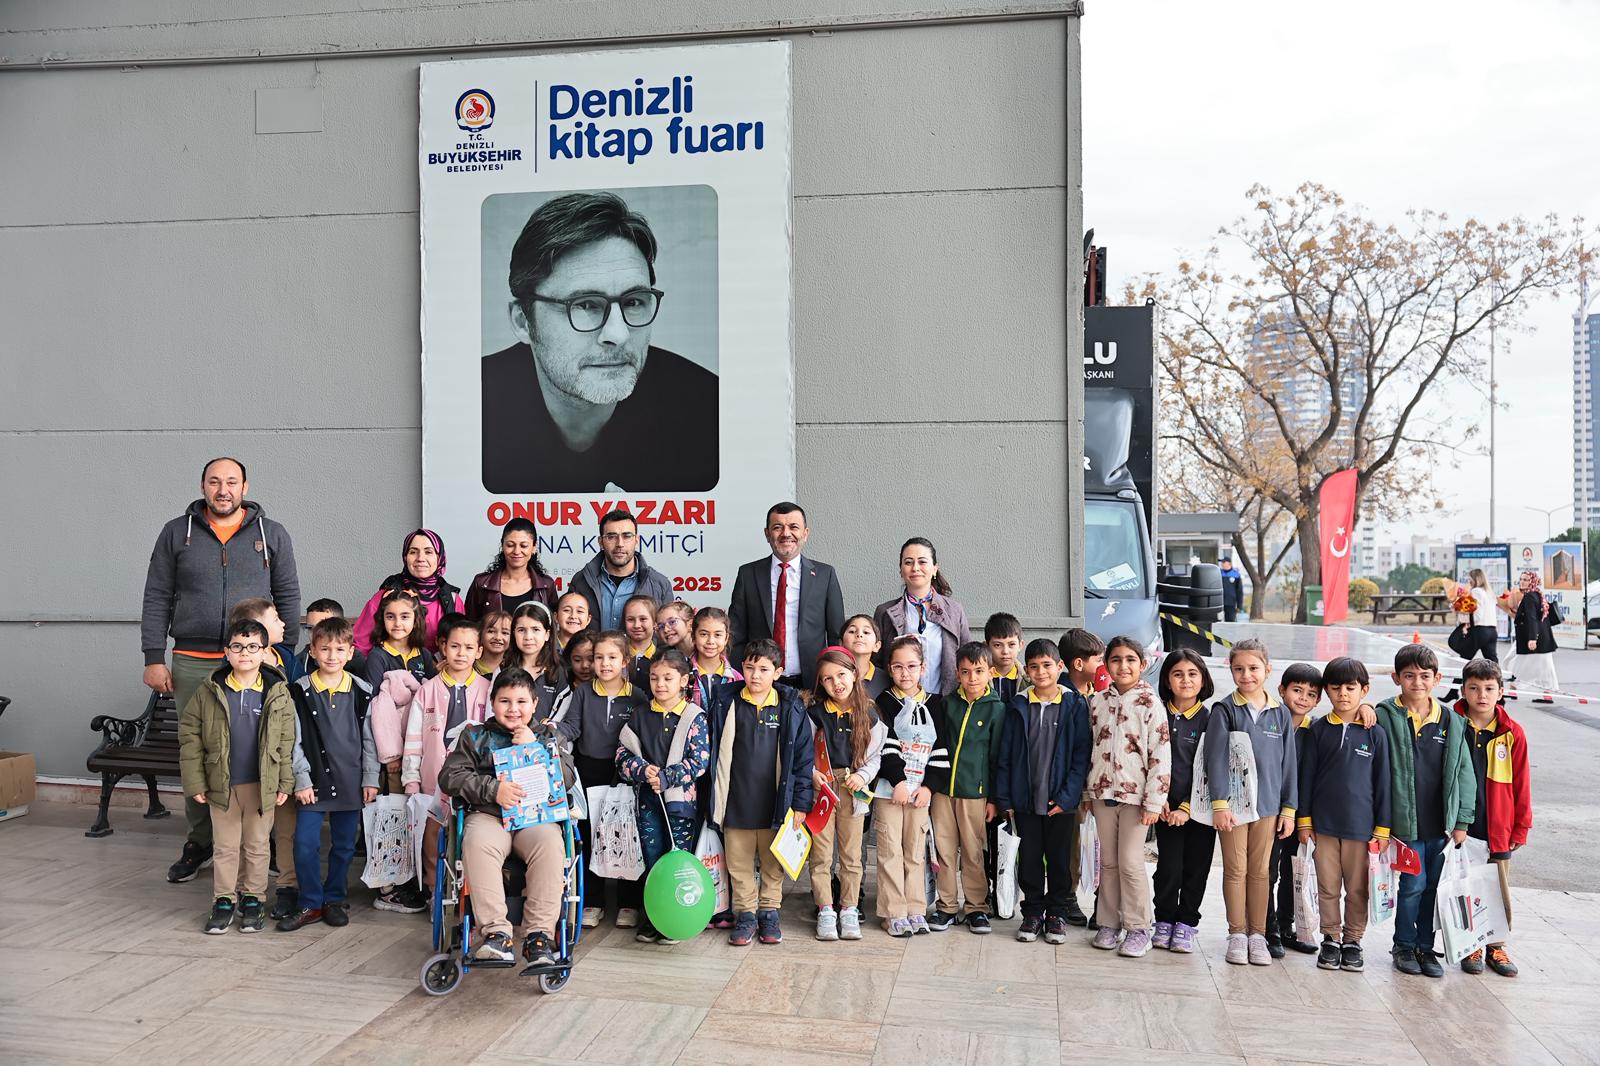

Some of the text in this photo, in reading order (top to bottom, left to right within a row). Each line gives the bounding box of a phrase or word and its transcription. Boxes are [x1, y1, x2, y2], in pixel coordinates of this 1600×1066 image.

[549, 75, 693, 120] Denizli
[468, 133, 485, 141] T.C.
[549, 116, 764, 165] kitap fuarı
[428, 149, 522, 165] BÜYÜKŞEHİR
[487, 501, 582, 526] ONUR
[538, 535, 573, 554] NA
[673, 576, 722, 592] 2025
